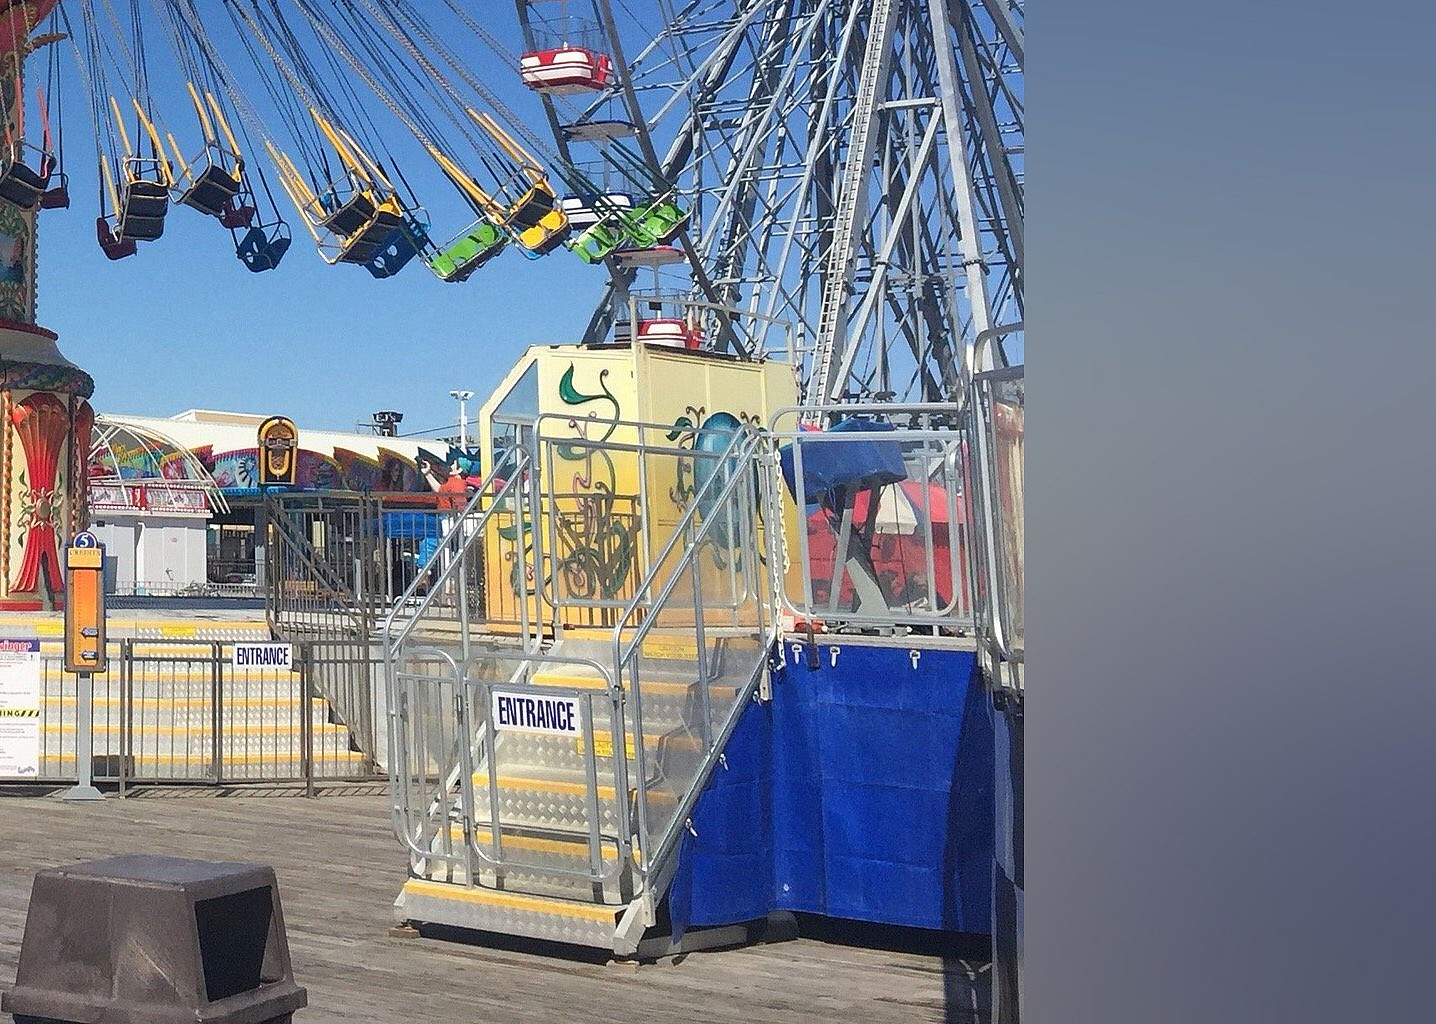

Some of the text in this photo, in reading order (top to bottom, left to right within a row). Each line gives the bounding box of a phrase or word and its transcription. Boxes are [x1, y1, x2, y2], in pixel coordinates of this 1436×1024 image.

[79, 534, 90, 548] 5
[237, 647, 289, 666] ENTRANCE
[498, 696, 576, 731] ENTRANCE
